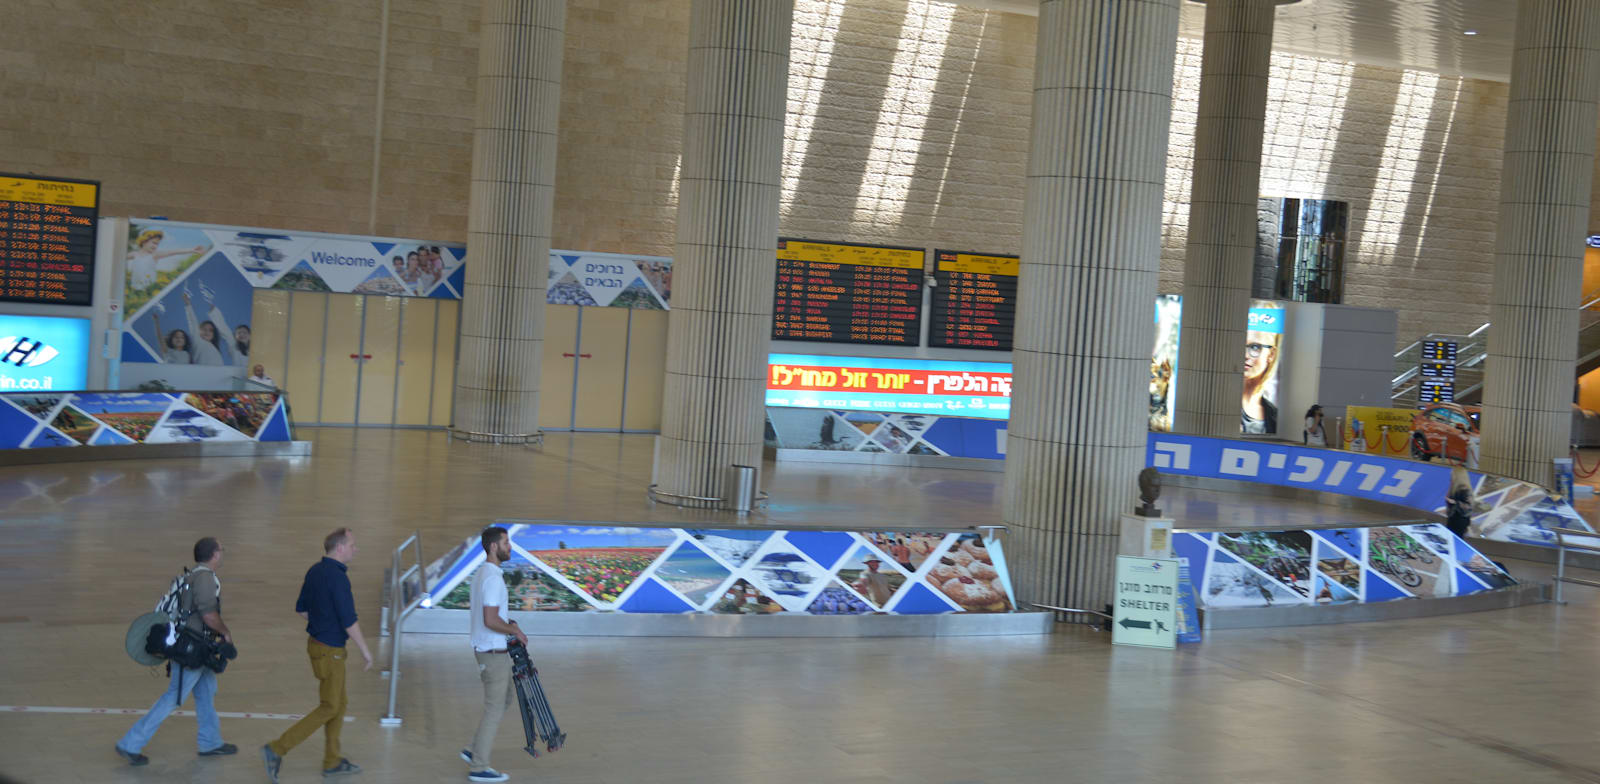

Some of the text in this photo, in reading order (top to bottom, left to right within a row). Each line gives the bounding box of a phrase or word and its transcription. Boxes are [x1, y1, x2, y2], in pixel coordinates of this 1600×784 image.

[312, 251, 376, 267] Welcome
[585, 263, 624, 275] ברוכים
[585, 277, 623, 288] הבאים
[841, 367, 869, 389] זול
[872, 372, 911, 390] יותר
[927, 372, 989, 394] הלפרין
[1219, 447, 1422, 498] ברוכים
[1119, 582, 1173, 595] מרחב מוגן
[1120, 598, 1170, 611] SHELTER
